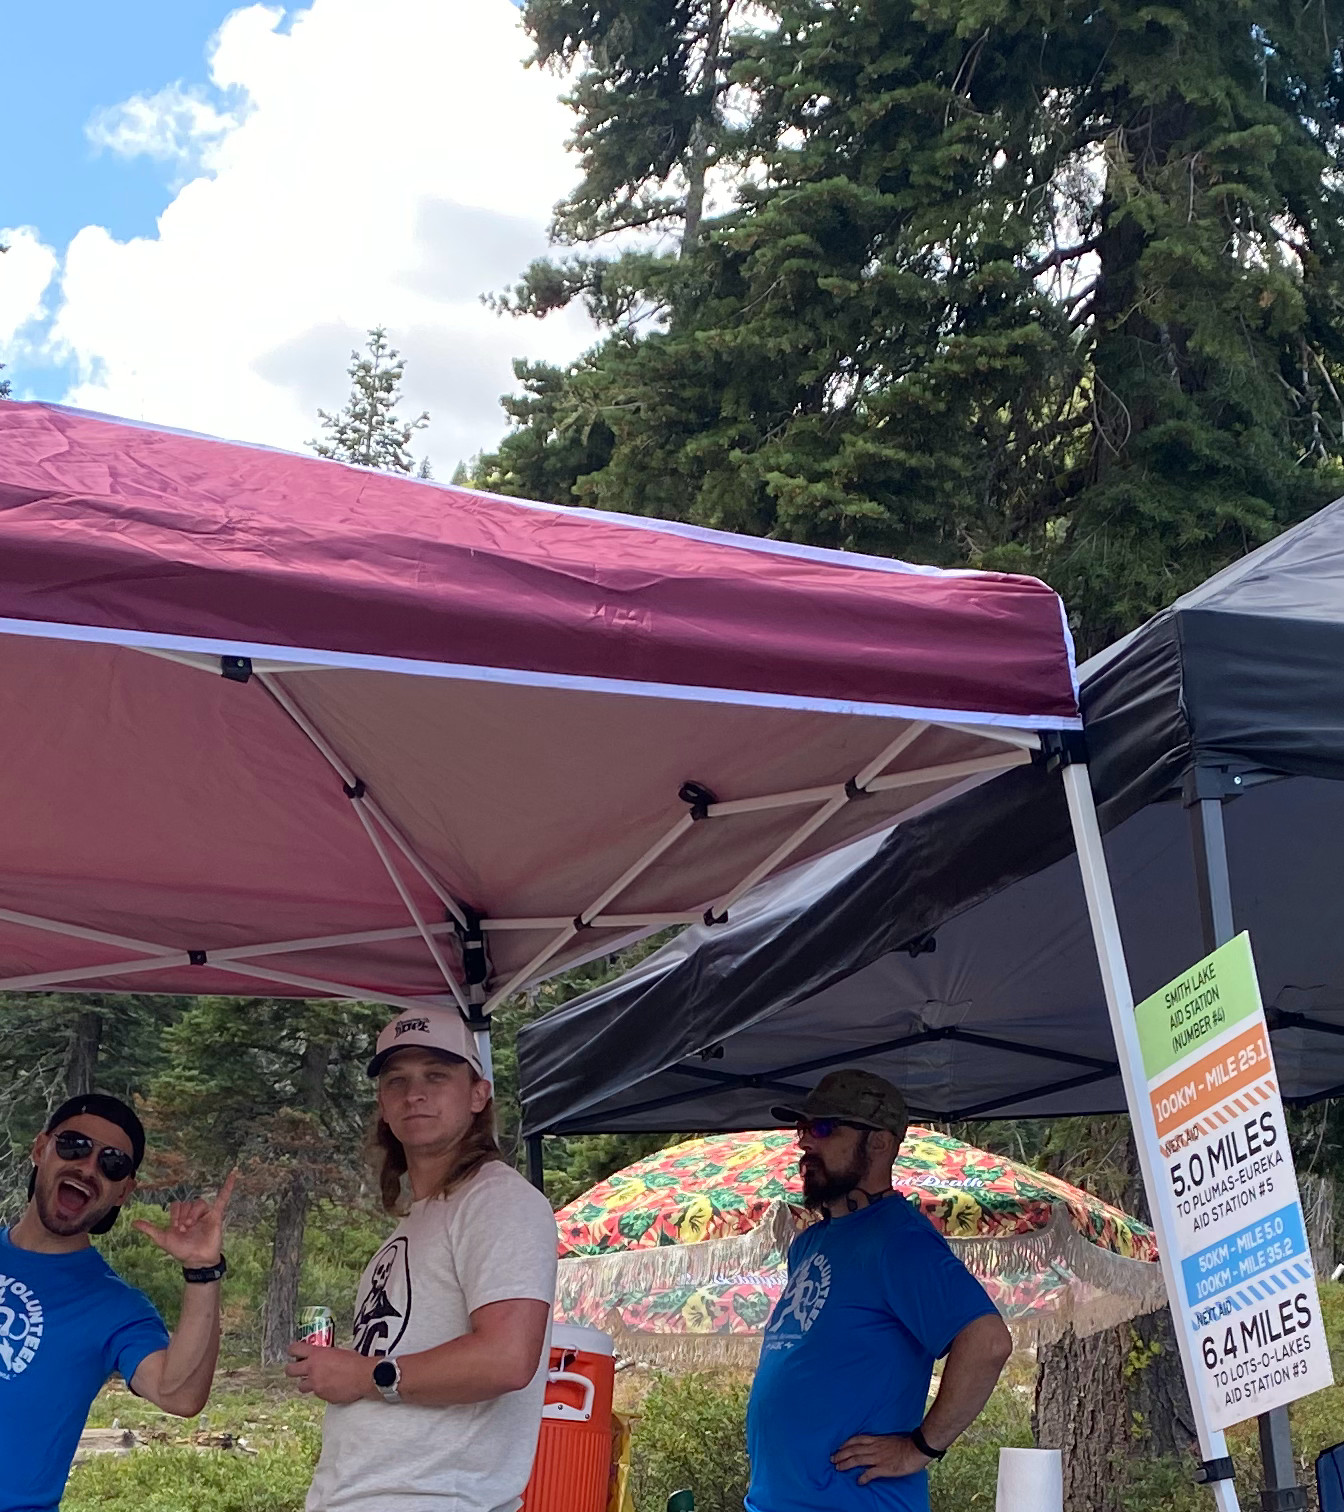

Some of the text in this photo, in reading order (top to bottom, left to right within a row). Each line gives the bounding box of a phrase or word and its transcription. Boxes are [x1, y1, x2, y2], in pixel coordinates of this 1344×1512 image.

[1164, 962, 1217, 1009] SMITH LAKE
[1170, 984, 1220, 1032] AID STATION
[1172, 1015, 1213, 1055] (NUMBER
[1156, 1081, 1197, 1123] 100KM
[1205, 1056, 1238, 1092] MILE
[1238, 1038, 1268, 1072] 25.1
[1164, 1125, 1199, 1155] NEXT AID
[1170, 1111, 1277, 1198] 5.0 MILES
[1176, 1149, 1284, 1218] TO PLUMAS-EUREKA
[1193, 1177, 1274, 1232] AID STATION #5
[1196, 1267, 1232, 1299] 100KM
[1239, 1250, 1267, 1278] MILE
[1267, 1237, 1294, 1264] 35.2
[1198, 1243, 1229, 1273] 50KM
[1236, 1226, 1264, 1254] MILE
[1264, 1217, 1284, 1240] 5.0
[1196, 1299, 1232, 1327] NEXT AID
[1202, 1293, 1311, 1370] 6.4 MILES
[1214, 1334, 1311, 1388] TO LOTS-O-LAKES
[1225, 1359, 1308, 1407] AID STATION #3
